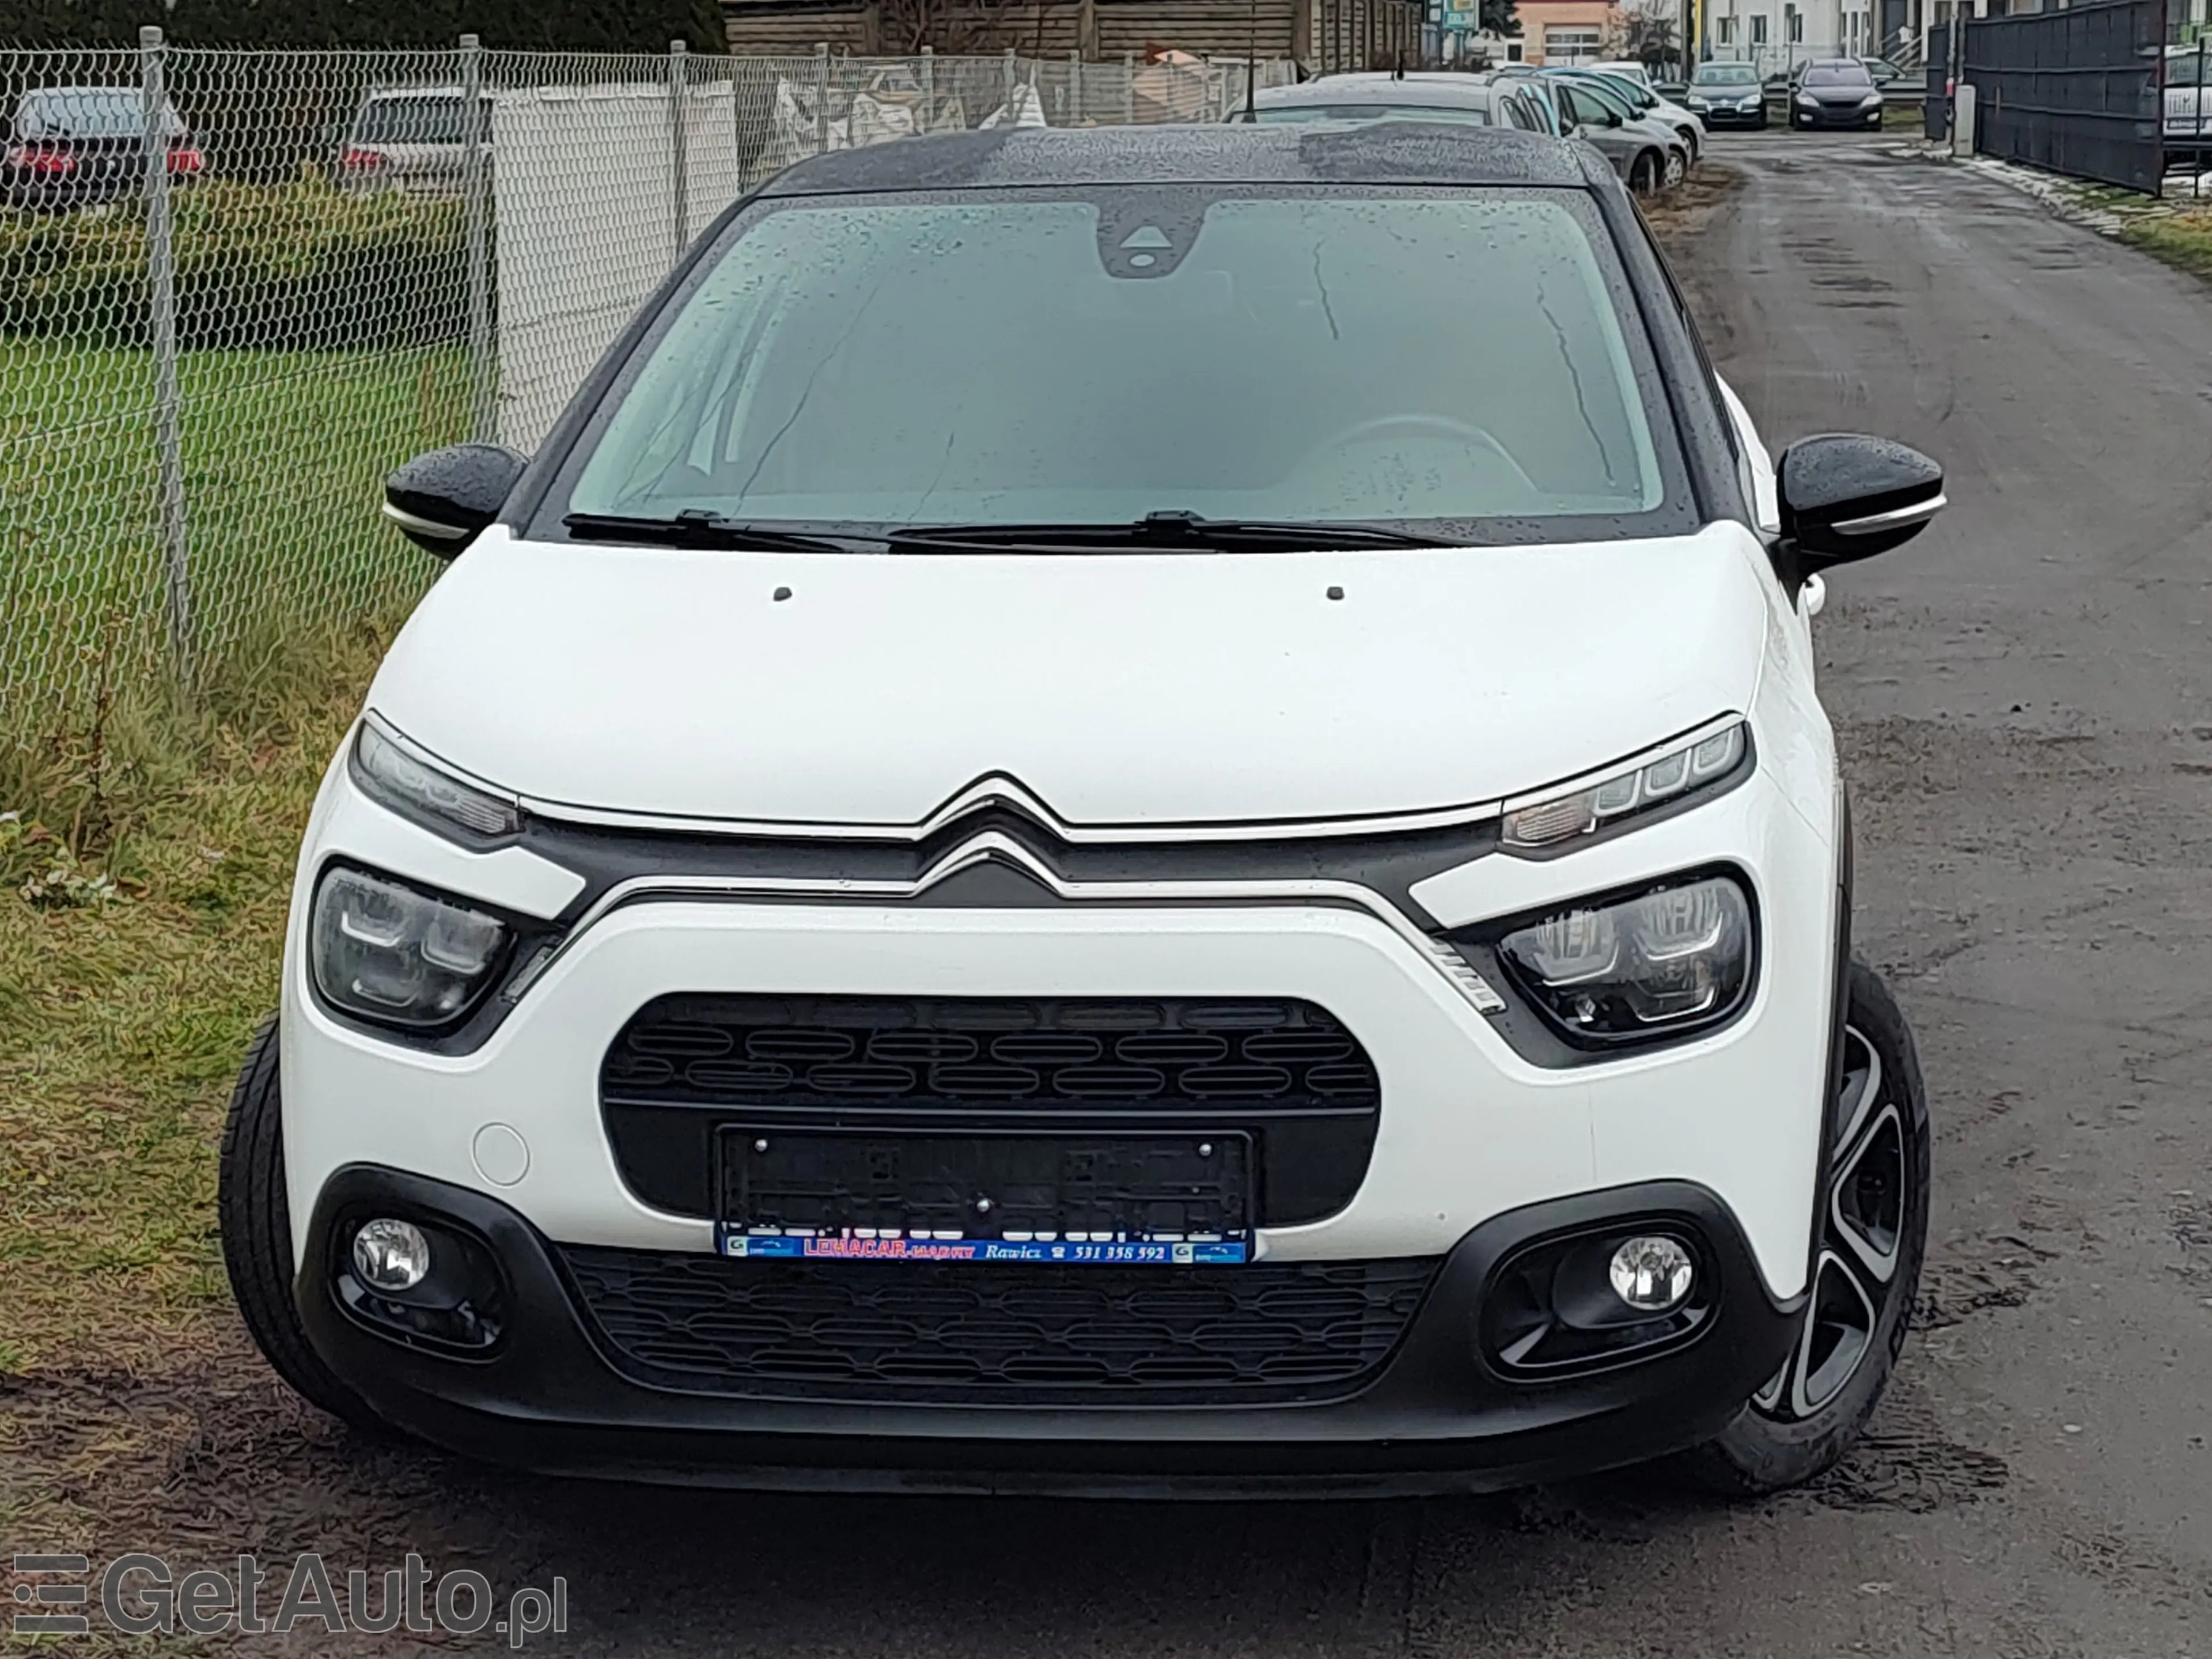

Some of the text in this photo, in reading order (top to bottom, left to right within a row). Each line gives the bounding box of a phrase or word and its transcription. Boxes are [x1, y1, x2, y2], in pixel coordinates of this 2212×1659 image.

[986, 1244, 1041, 1259] Rawicz
[1074, 1246, 1101, 1259] 531
[1137, 1247, 1165, 1260] 592
